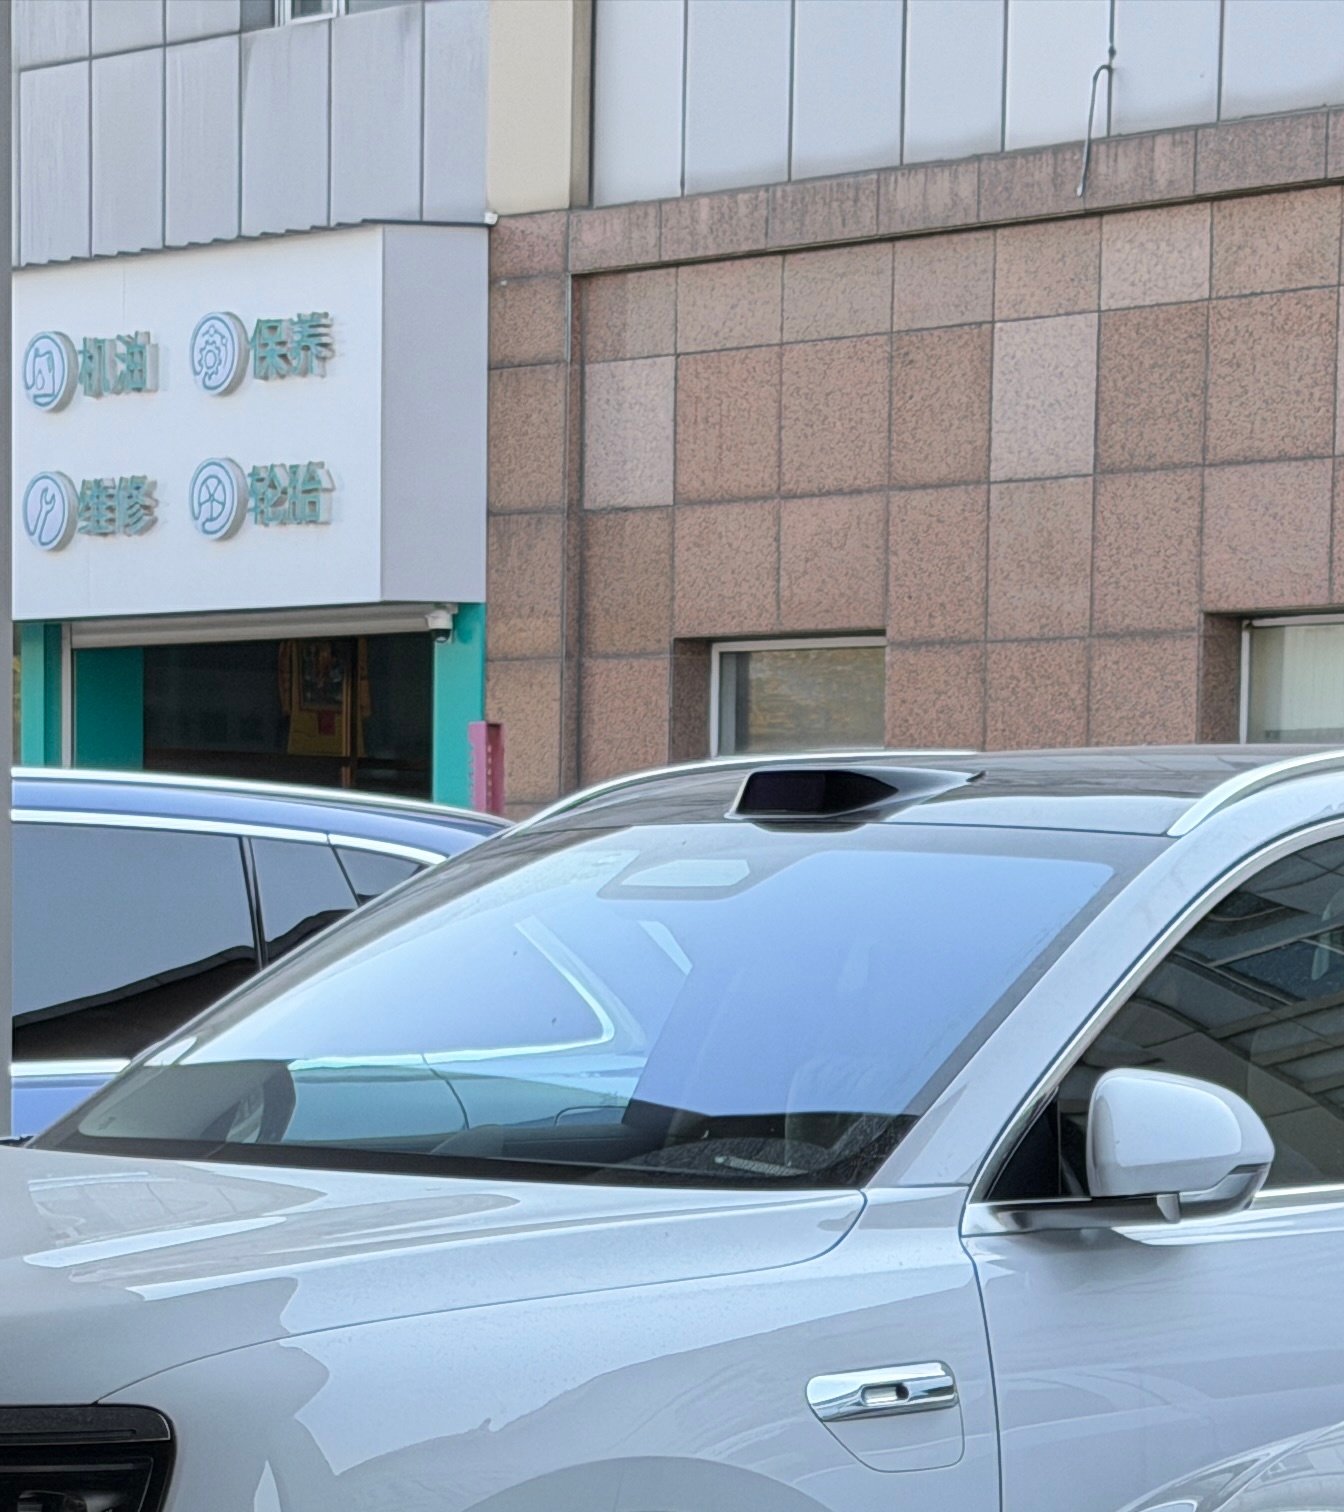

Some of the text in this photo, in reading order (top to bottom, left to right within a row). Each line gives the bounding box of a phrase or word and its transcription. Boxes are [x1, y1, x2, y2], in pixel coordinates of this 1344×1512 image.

[251, 312, 331, 380] 保养
[77, 475, 157, 536] 维修
[247, 461, 330, 526] 轮胎
